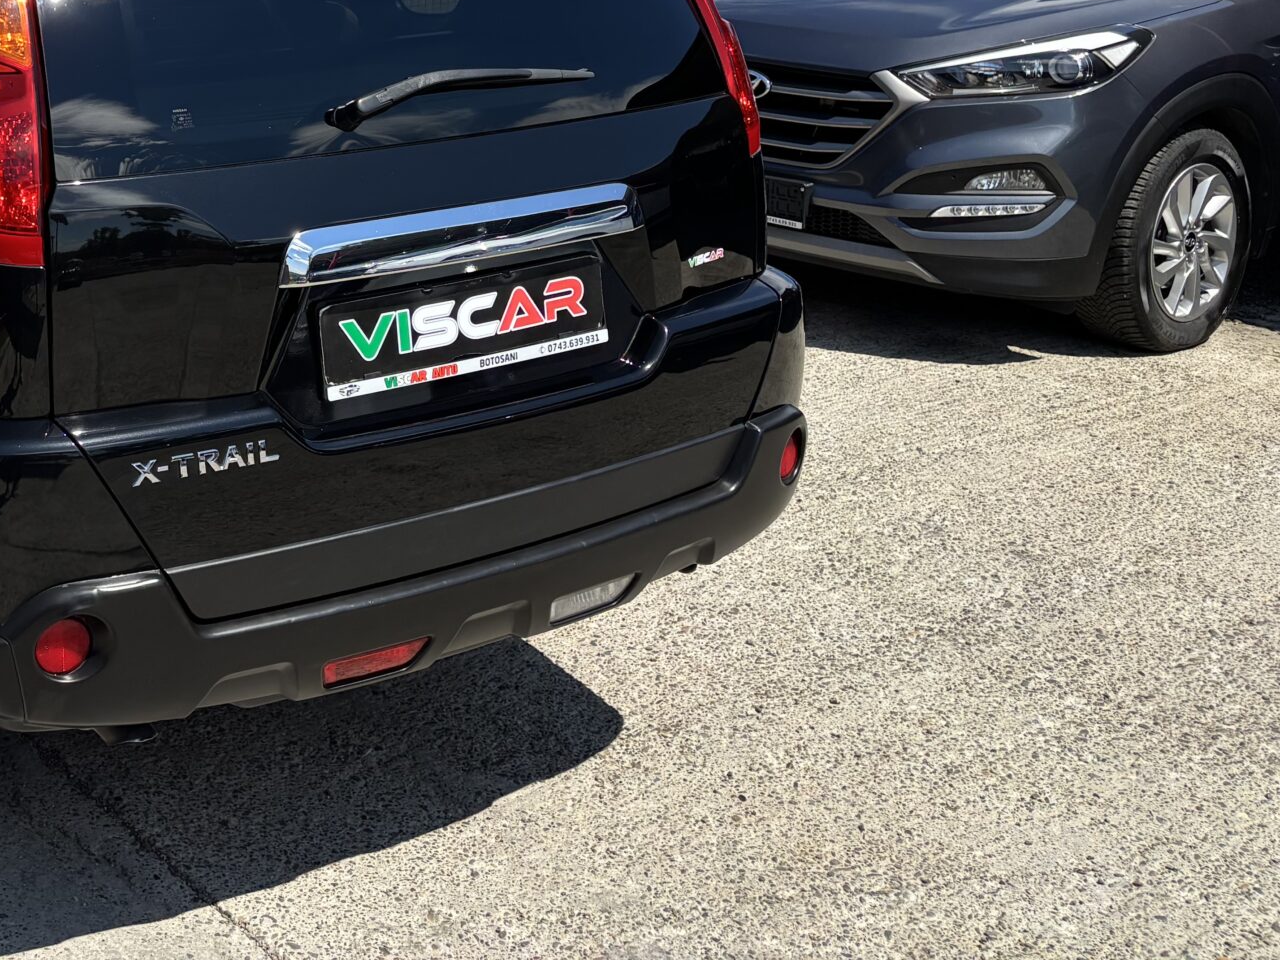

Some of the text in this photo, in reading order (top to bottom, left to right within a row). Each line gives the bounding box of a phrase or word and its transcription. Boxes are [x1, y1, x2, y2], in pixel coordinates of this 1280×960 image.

[687, 247, 724, 268] VISCAR
[339, 276, 587, 361] VISCAR
[384, 333, 600, 389] VISCAR AUTO BOTOSANI 0743.639.931
[131, 440, 280, 487] X-TRAIL
